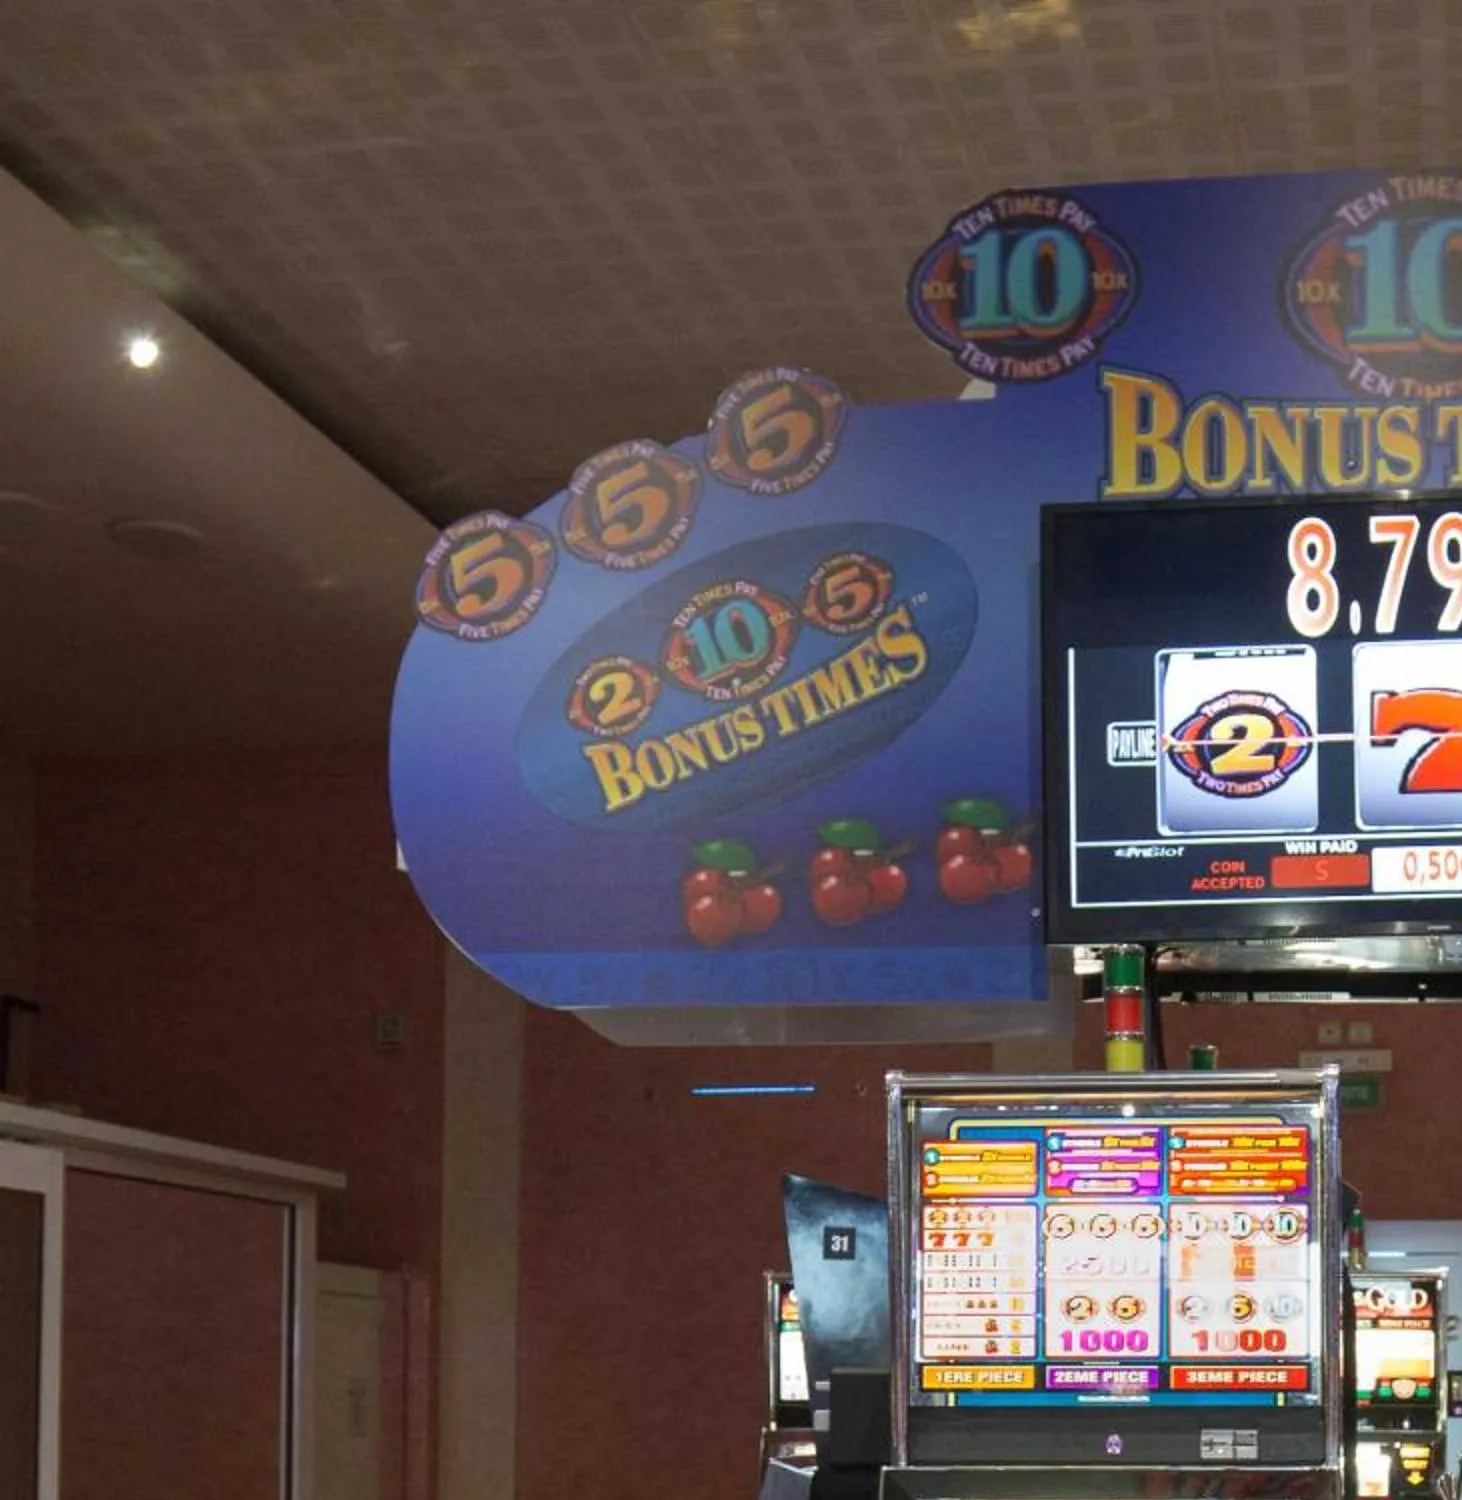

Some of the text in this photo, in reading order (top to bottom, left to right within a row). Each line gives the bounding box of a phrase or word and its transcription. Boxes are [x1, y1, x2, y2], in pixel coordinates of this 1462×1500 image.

[953, 196, 1096, 241] TEN TIMES PAY
[1337, 187, 1389, 228] TEN
[958, 227, 1090, 330] 10
[960, 336, 1096, 378] TEN TIMES PAY
[1348, 356, 1396, 398] TEN
[740, 384, 813, 472] 5
[1102, 370, 1425, 496] BONUS
[596, 461, 670, 546] 5
[451, 532, 524, 618] 5
[825, 566, 872, 620] 5
[686, 600, 770, 680] 10
[583, 604, 928, 811] BONUS TIMES
[590, 671, 642, 726] 2
[1210, 713, 1276, 775] 2
[1200, 769, 1283, 794] TWO TIMES PAY
[1210, 860, 1246, 874] COIN
[1285, 840, 1358, 855] WIN PAID
[1402, 850, 1460, 885] 0,50
[1191, 875, 1265, 891] ACCEPTED
[830, 1235, 849, 1252] 31
[1365, 1285, 1428, 1313] GOD
[1058, 1329, 1149, 1353] 1000
[1191, 1329, 1288, 1353] 1000
[936, 1371, 1025, 1384] 1ERE PIECE
[1055, 1371, 1149, 1384] 2EME PIECE
[1186, 1371, 1289, 1384] 3EME PIECE
